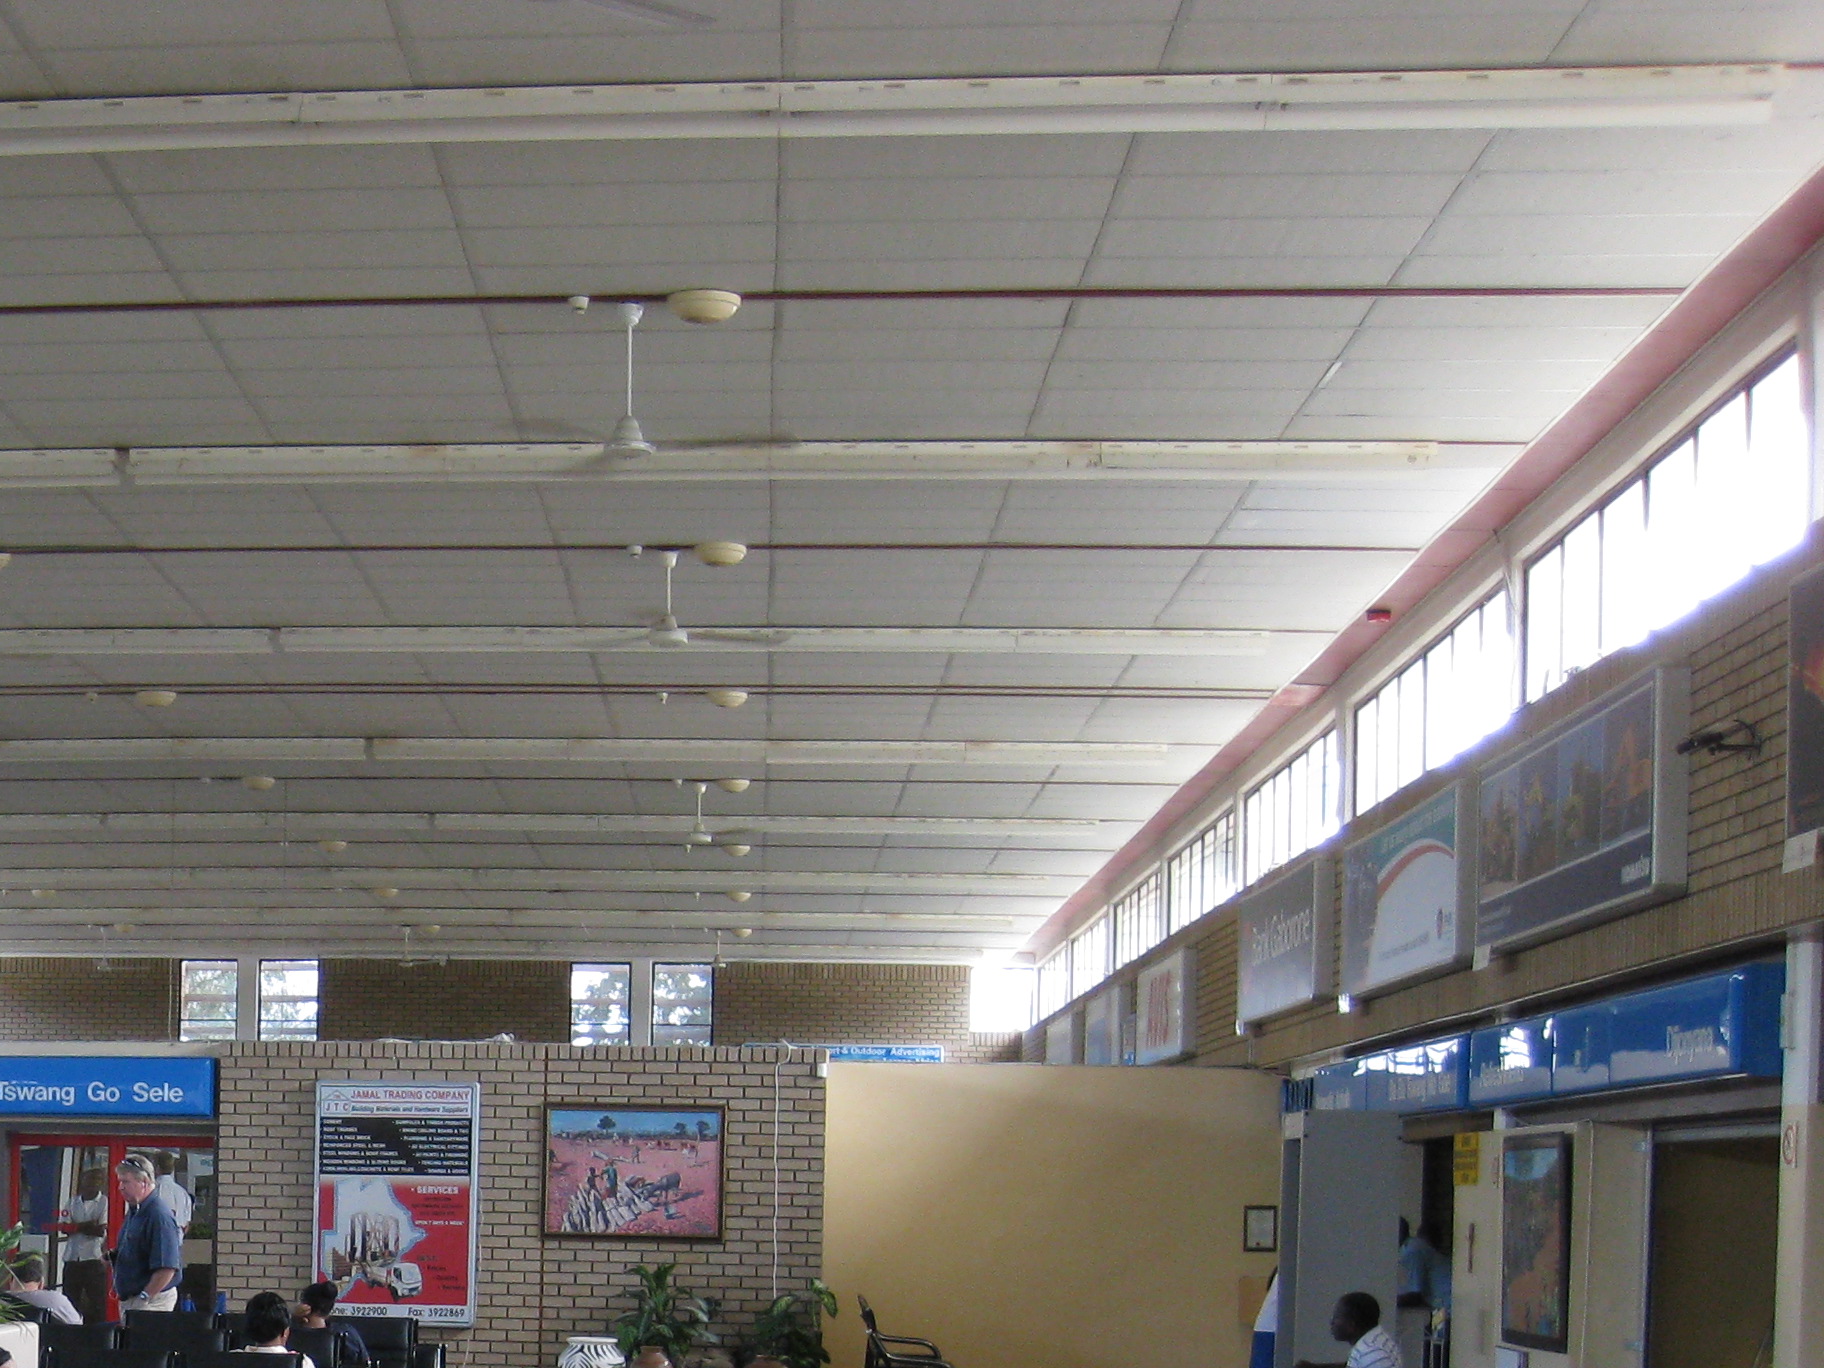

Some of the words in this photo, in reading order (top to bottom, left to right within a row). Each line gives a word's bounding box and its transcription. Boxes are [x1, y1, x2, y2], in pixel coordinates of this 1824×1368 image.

[851, 1047, 886, 1055] Outdoor
[890, 1047, 940, 1058] Advertising
[88, 1081, 120, 1102] Go
[132, 1081, 184, 1103] Sele
[350, 1090, 380, 1099] JAMAL
[384, 1090, 422, 1100] TRADING
[425, 1090, 470, 1100] COMPANY
[326, 1103, 330, 1111] J
[333, 1103, 339, 1111] T
[343, 1103, 349, 1111] C
[351, 1105, 374, 1113] Building
[416, 1185, 459, 1194] SERVICES
[351, 1306, 387, 1316] 3922900
[428, 1308, 465, 1317] 3922869
